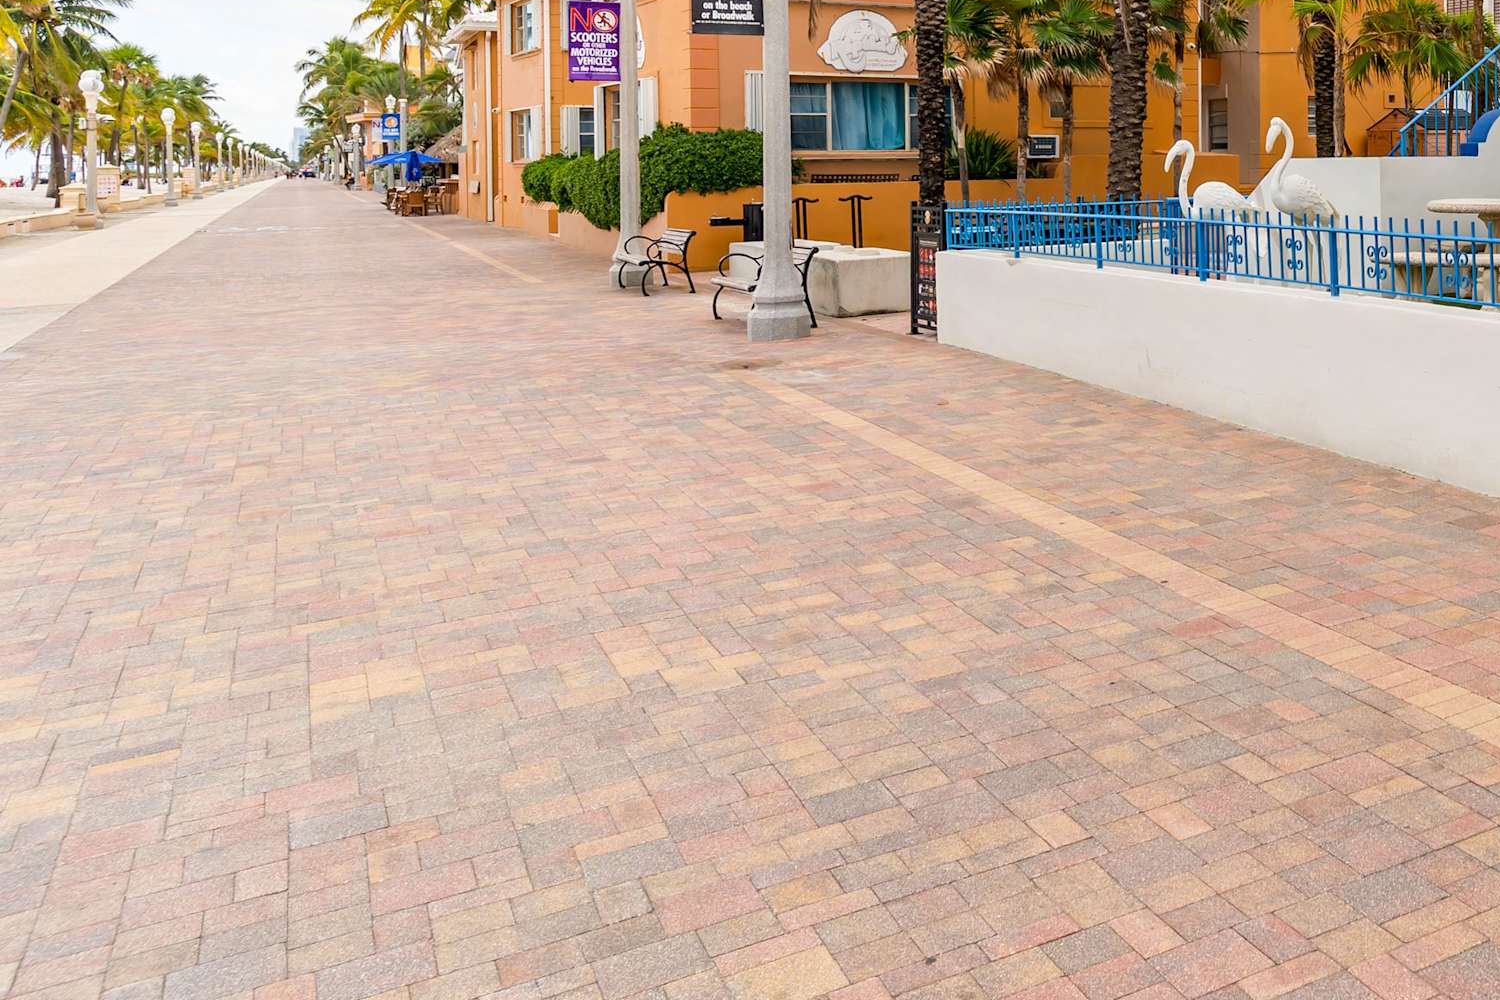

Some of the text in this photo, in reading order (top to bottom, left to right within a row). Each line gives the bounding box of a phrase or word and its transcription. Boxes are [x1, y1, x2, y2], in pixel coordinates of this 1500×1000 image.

[703, 0, 753, 11] on the beach
[570, 7, 618, 32] NO
[712, 10, 755, 21] Broadwalk
[570, 32, 618, 44] SCOOTERS
[570, 47, 618, 57] MOTORIZED
[577, 57, 612, 66] VEHICLES
